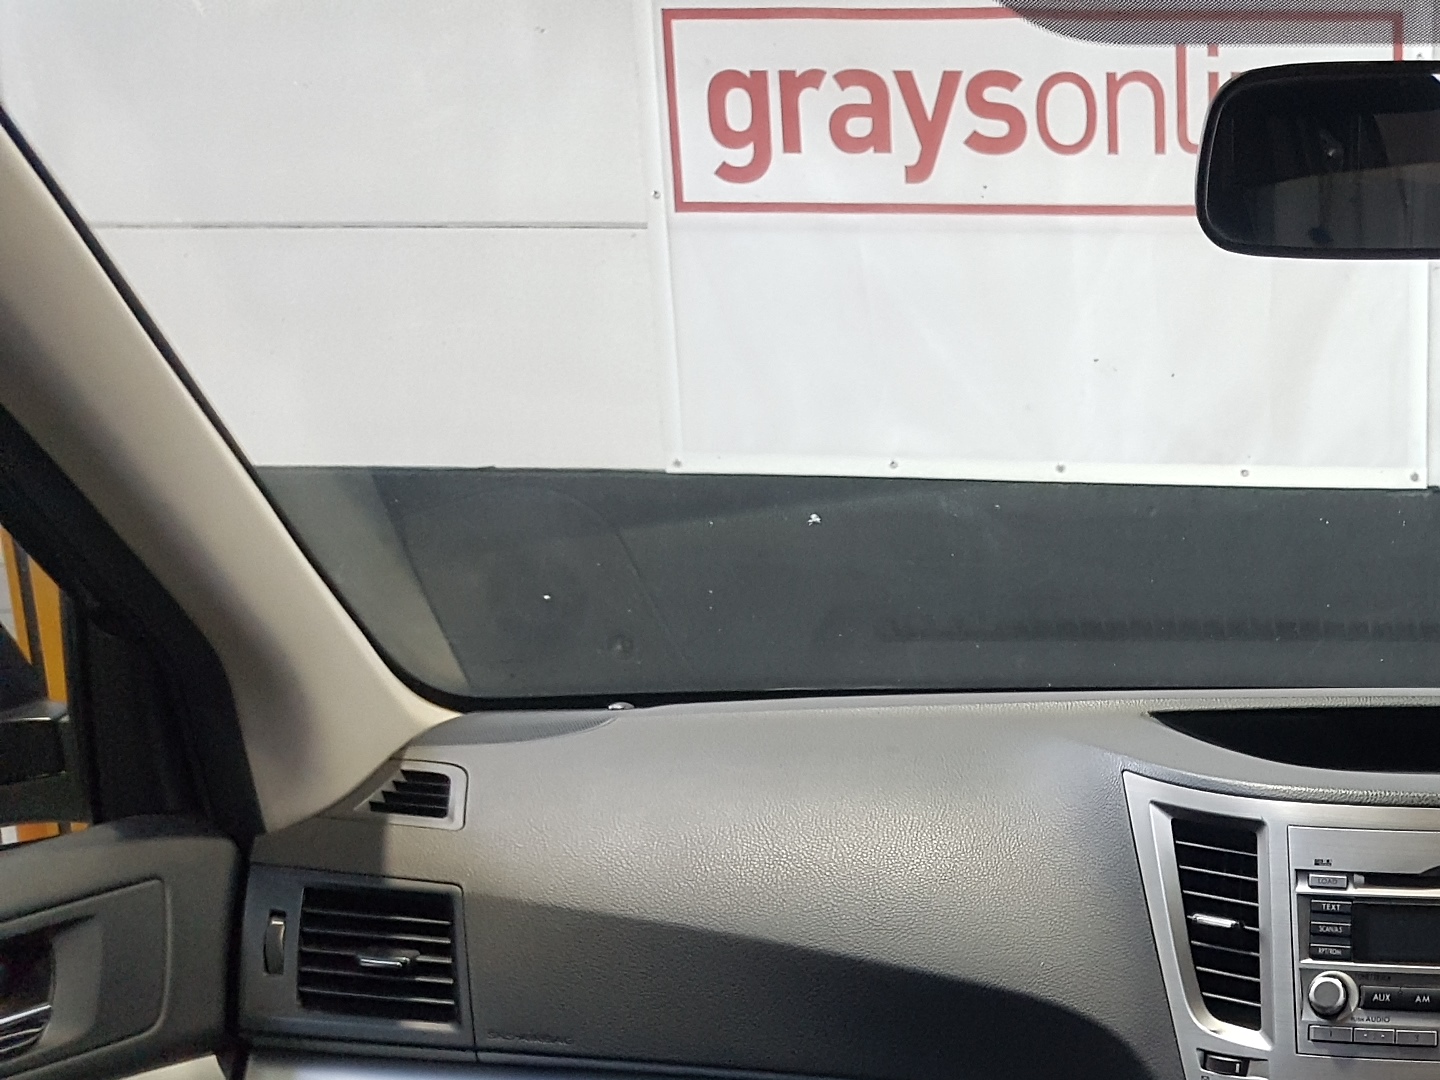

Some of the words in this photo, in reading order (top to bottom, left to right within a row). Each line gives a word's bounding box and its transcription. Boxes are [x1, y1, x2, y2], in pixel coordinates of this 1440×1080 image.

[1322, 903, 1341, 911] TEXT
[1372, 993, 1391, 1002] AUX
[1415, 995, 1430, 1003] AM
